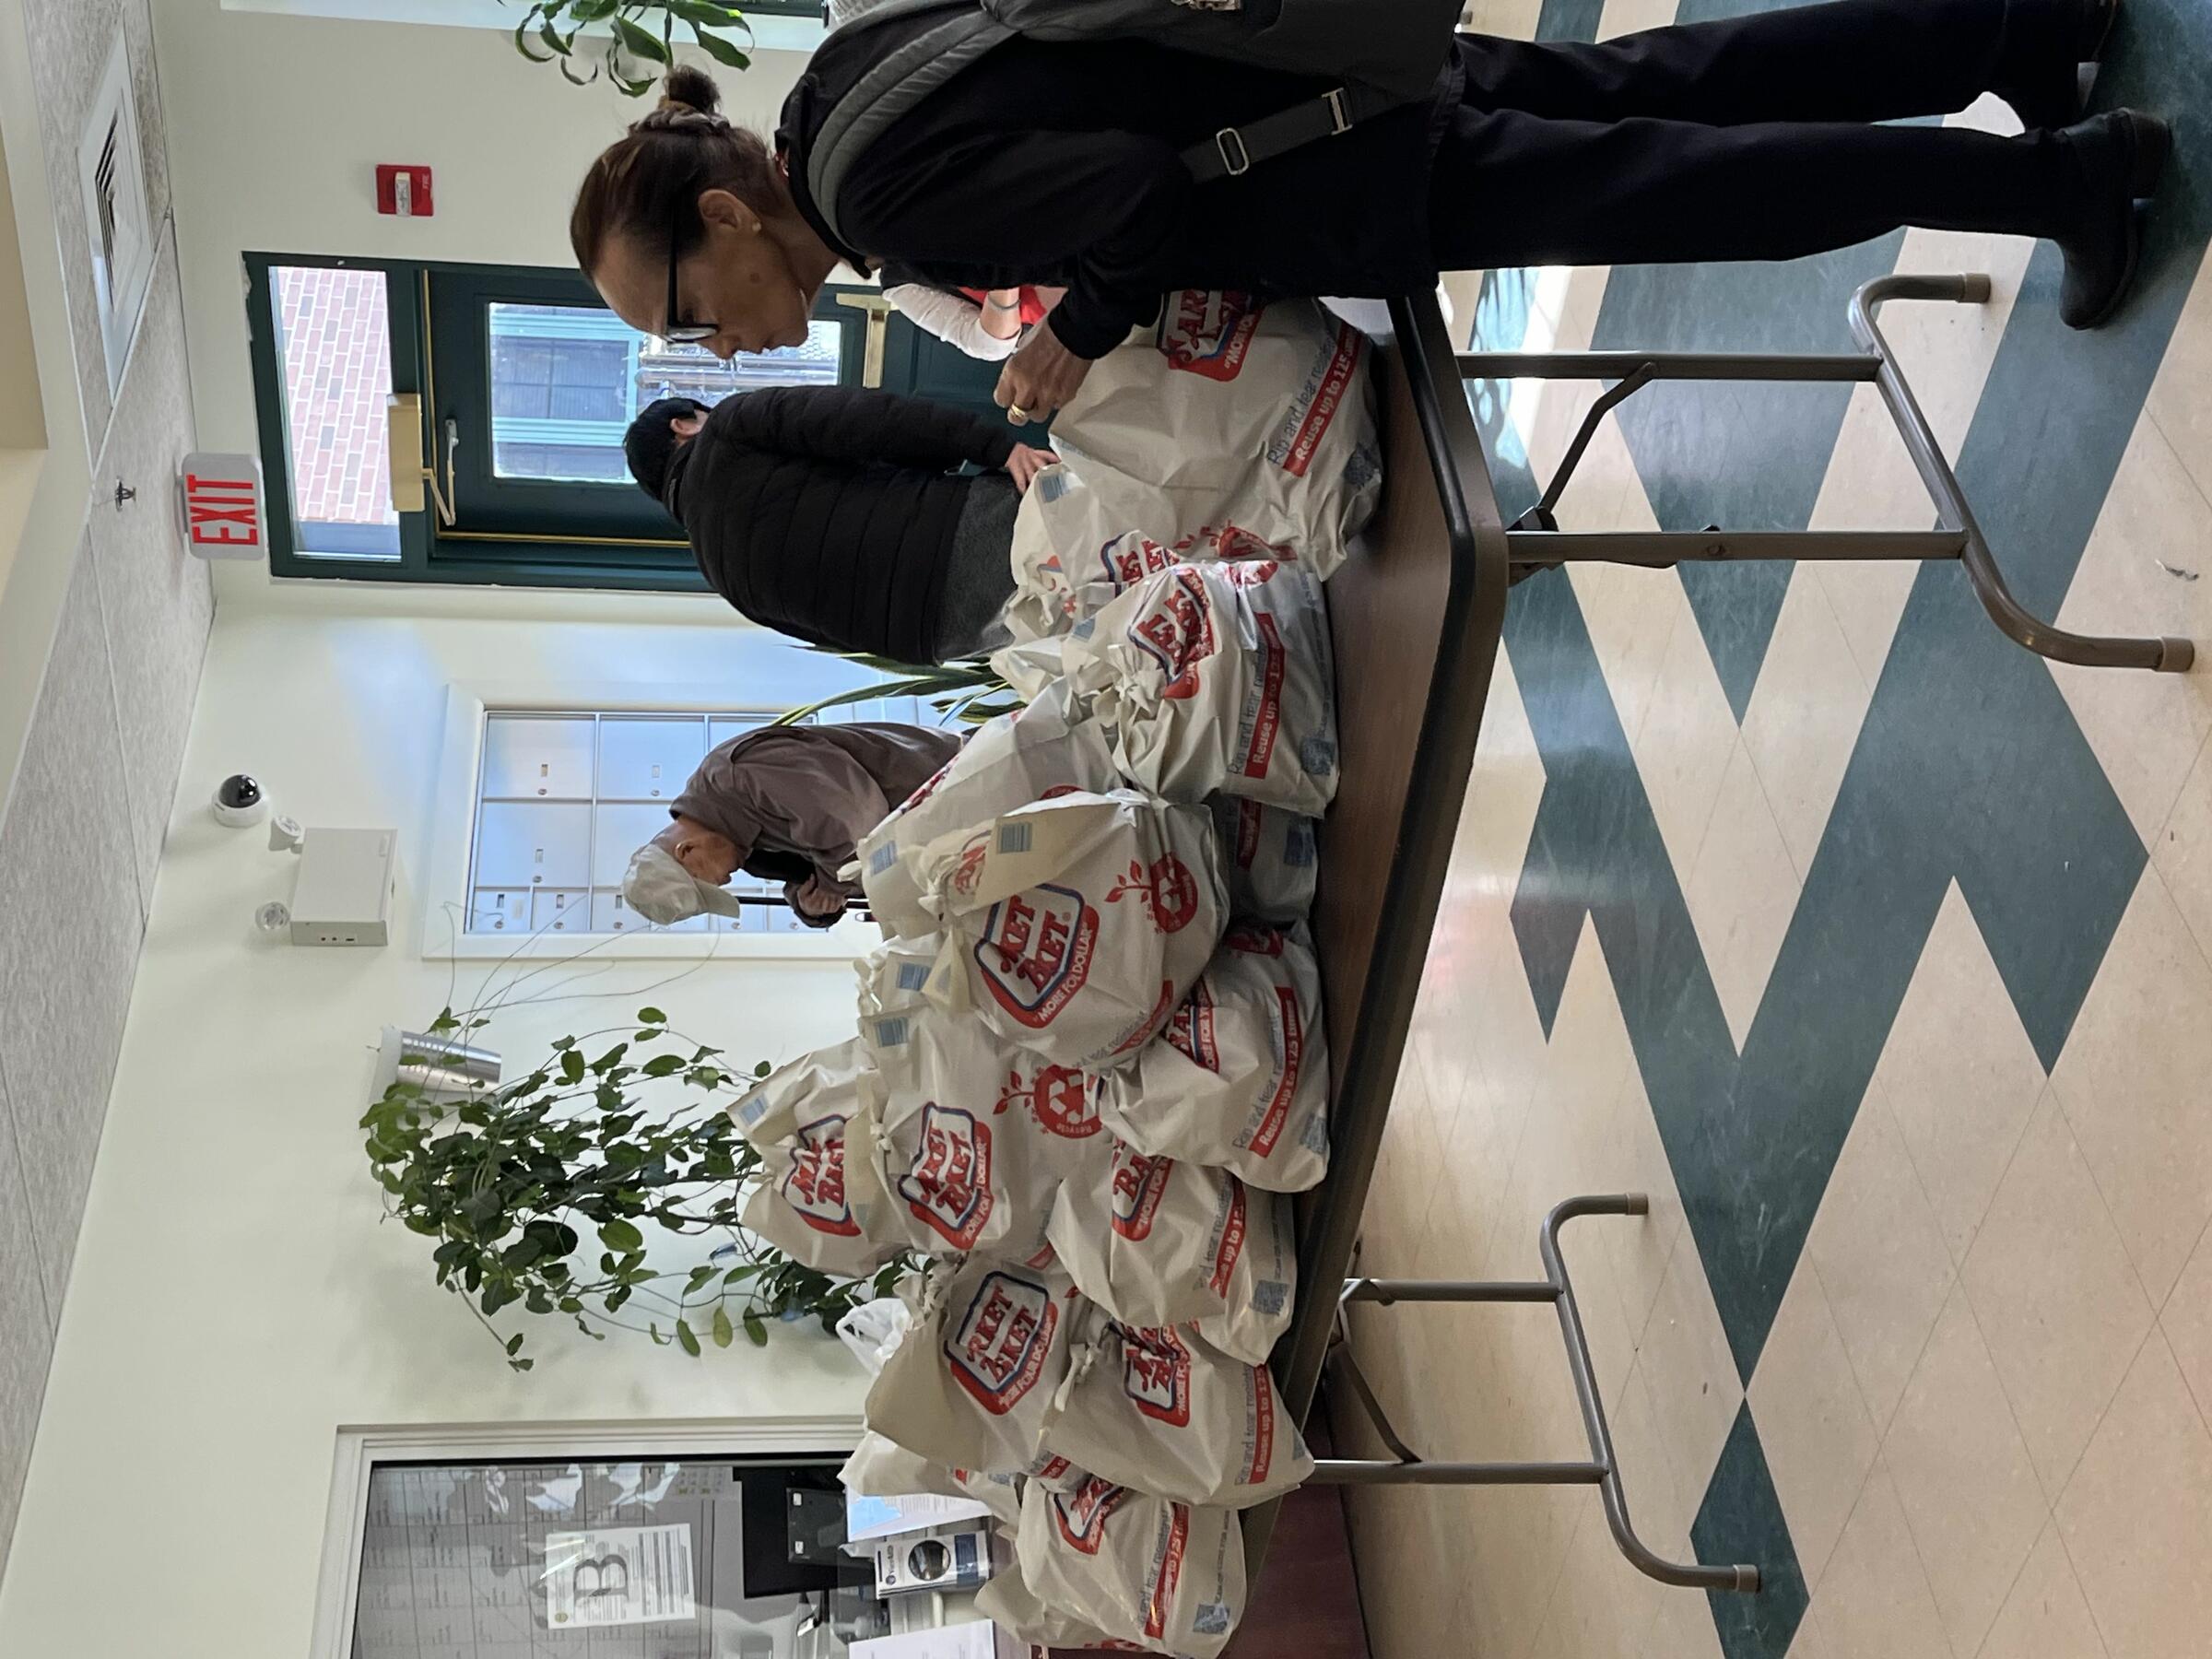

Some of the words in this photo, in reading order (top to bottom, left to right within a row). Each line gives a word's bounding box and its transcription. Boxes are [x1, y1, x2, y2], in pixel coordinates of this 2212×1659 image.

[1334, 354, 1351, 379] 125
[1325, 381, 1341, 394] to
[1318, 396, 1335, 414] up
[1265, 440, 1290, 465] Rip
[1282, 406, 1305, 437] and
[1295, 416, 1324, 460] Reuse
[186, 475, 258, 546] EXIT
[1268, 683, 1277, 698] to
[1265, 700, 1278, 720] up
[1252, 722, 1273, 764] Reuse
[1288, 1041, 1299, 1066] 125
[1284, 1069, 1296, 1087] to
[1278, 1088, 1292, 1106] up
[1258, 1109, 1285, 1147] Reuse
[1227, 1230, 1241, 1244] to
[1223, 1246, 1236, 1262] up
[1260, 1397, 1269, 1411] to
[1261, 1415, 1272, 1431] up
[1255, 1434, 1269, 1472] Reuse
[572, 1554, 629, 1606] B
